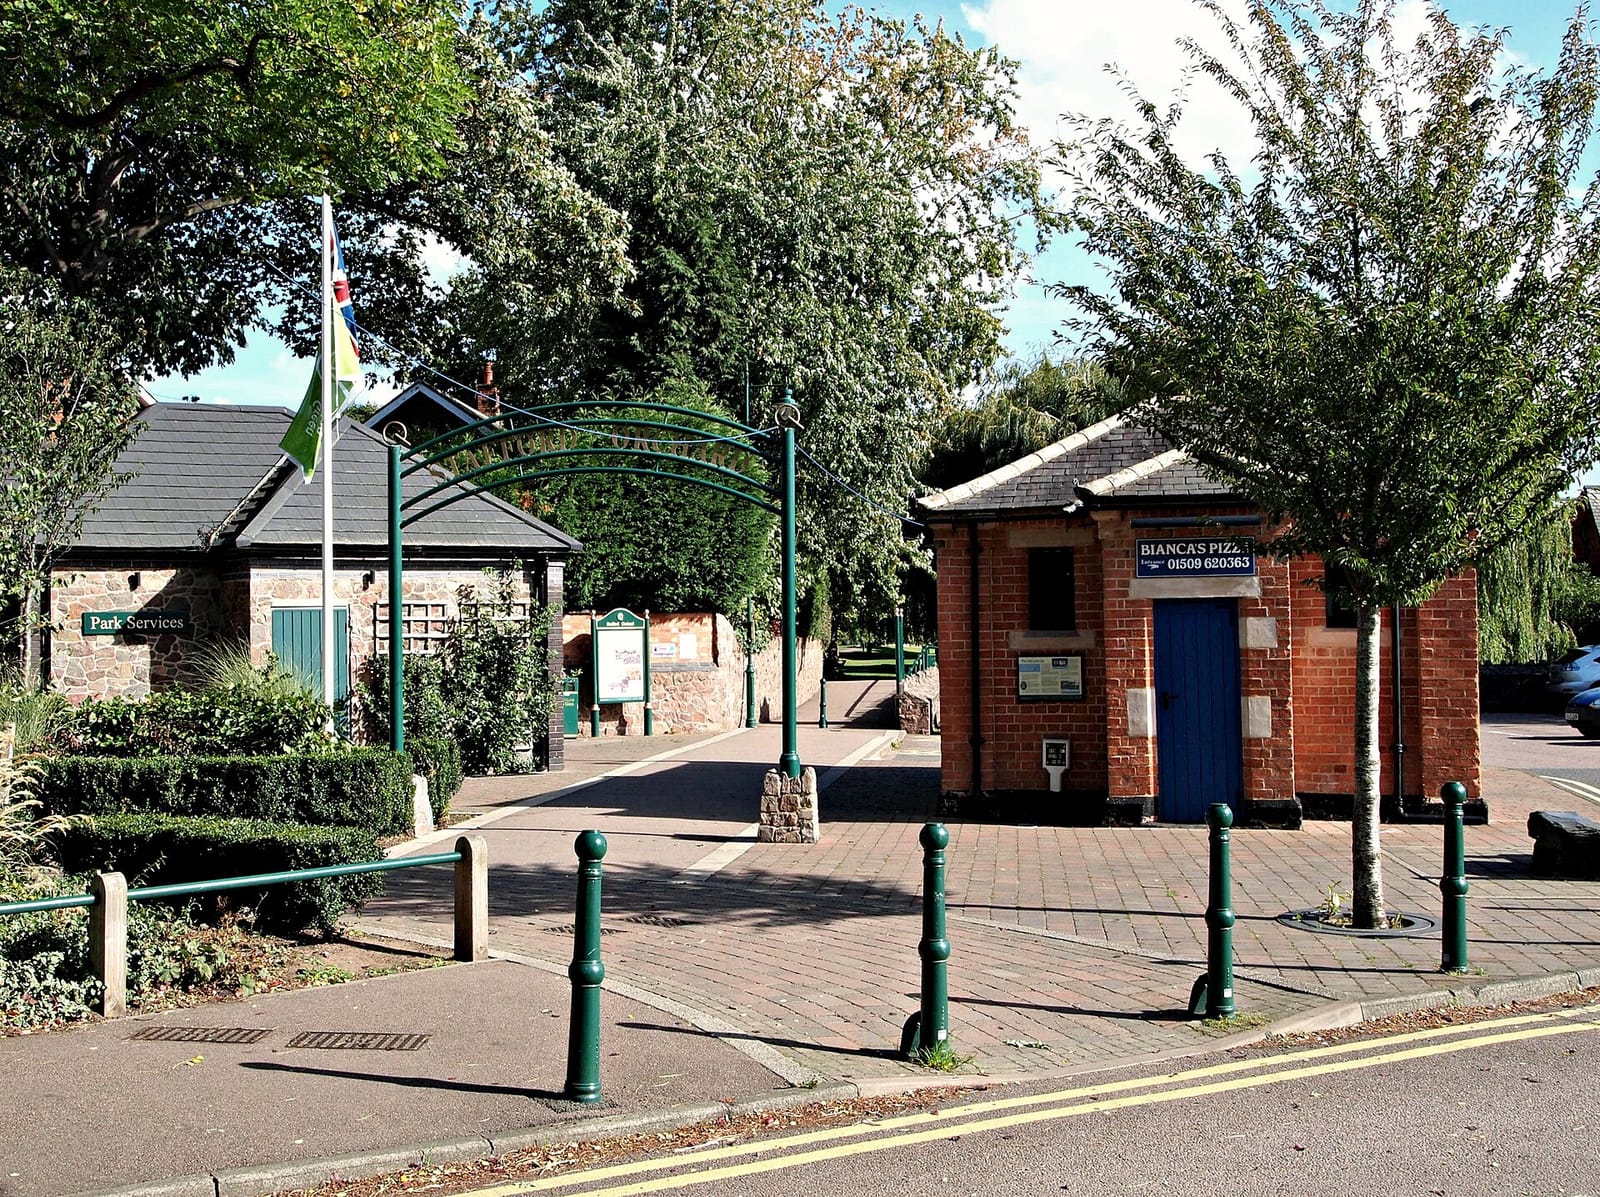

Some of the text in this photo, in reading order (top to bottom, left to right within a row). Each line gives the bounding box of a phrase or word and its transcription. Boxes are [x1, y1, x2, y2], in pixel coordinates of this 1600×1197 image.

[1140, 543, 1207, 556] BIANCA'S
[1167, 557, 1250, 570] 01509 620363
[89, 615, 184, 630] Park Services
